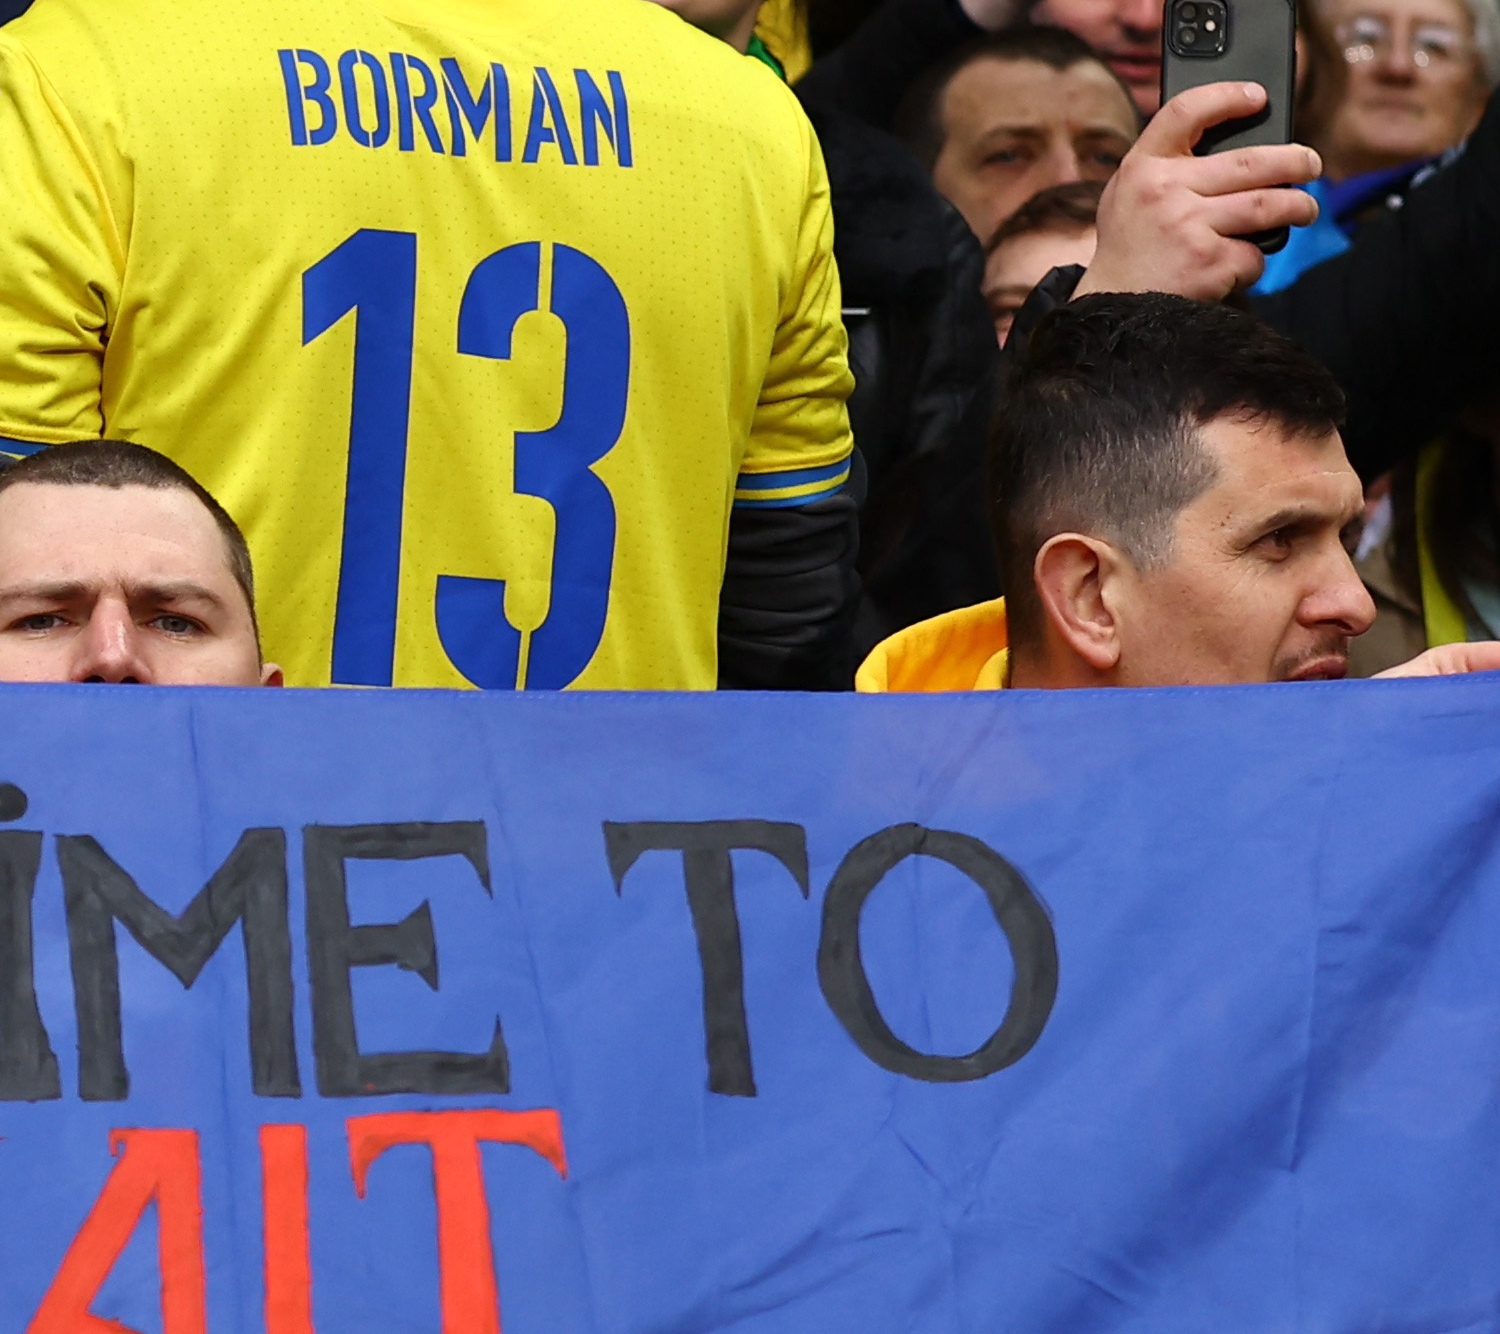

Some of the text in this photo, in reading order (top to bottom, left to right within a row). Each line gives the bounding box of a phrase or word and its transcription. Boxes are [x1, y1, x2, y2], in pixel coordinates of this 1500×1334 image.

[277, 48, 634, 168] BORMAN
[301, 227, 632, 691] 13
[602, 819, 1060, 1098] TO
